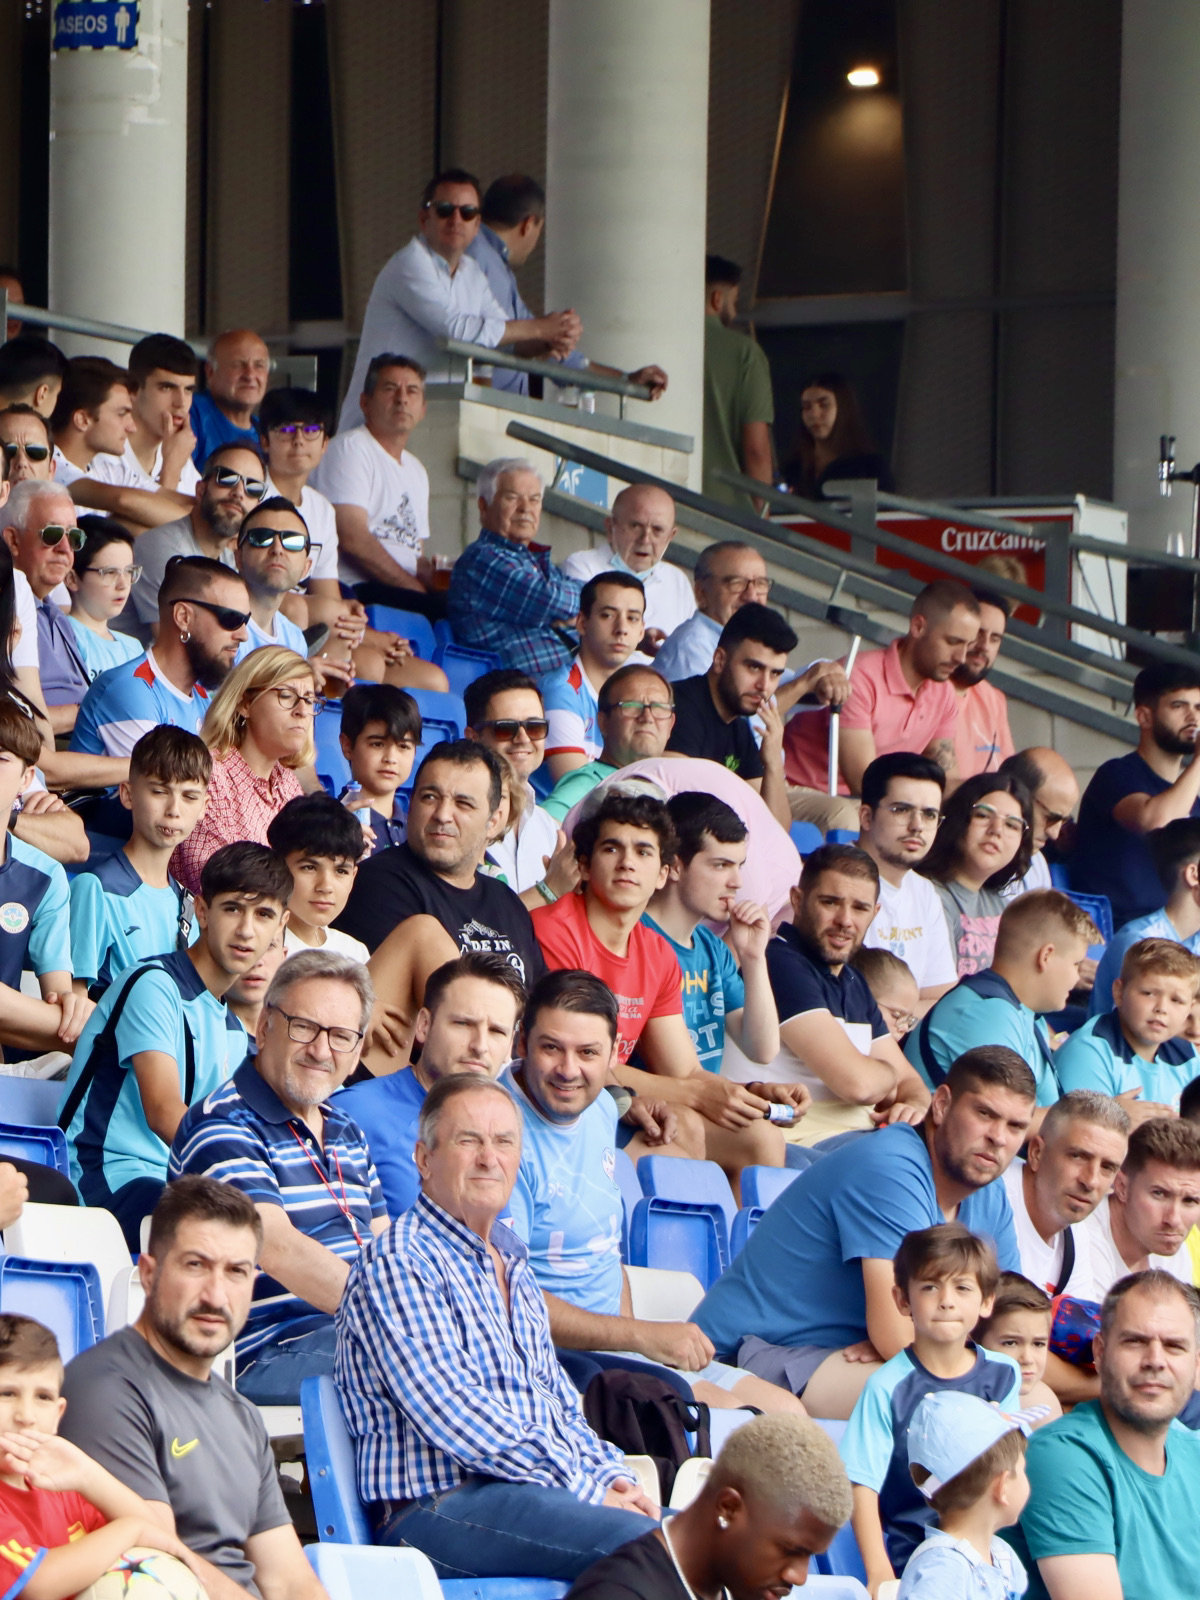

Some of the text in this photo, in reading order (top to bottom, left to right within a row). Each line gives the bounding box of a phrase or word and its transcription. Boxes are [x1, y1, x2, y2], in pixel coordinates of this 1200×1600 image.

[58, 15, 107, 33] ASEOS
[941, 527, 1046, 552] Cruzcamp
[494, 940, 511, 951] IN
